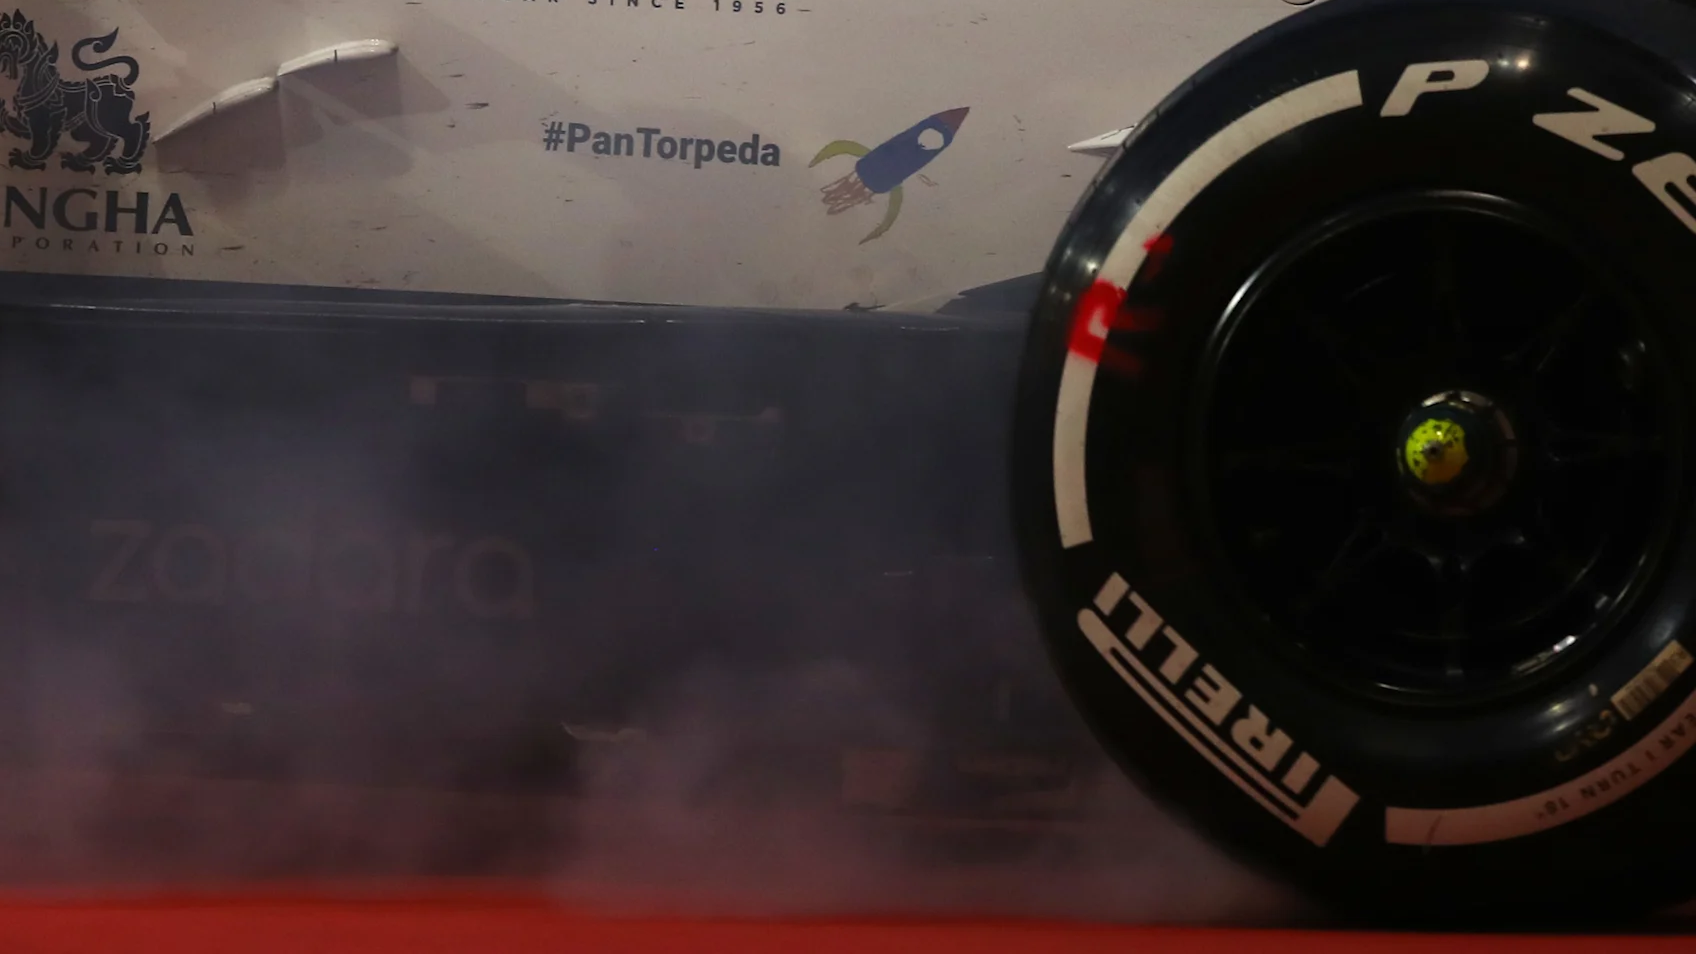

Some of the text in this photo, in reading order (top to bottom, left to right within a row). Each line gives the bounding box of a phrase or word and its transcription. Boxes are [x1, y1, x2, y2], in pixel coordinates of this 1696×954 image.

[713, 0, 786, 15] 1956
[543, 121, 781, 169] #PanTorpeda
[1077, 571, 1360, 847] PIRELLI
[1579, 761, 1642, 800] TURN
